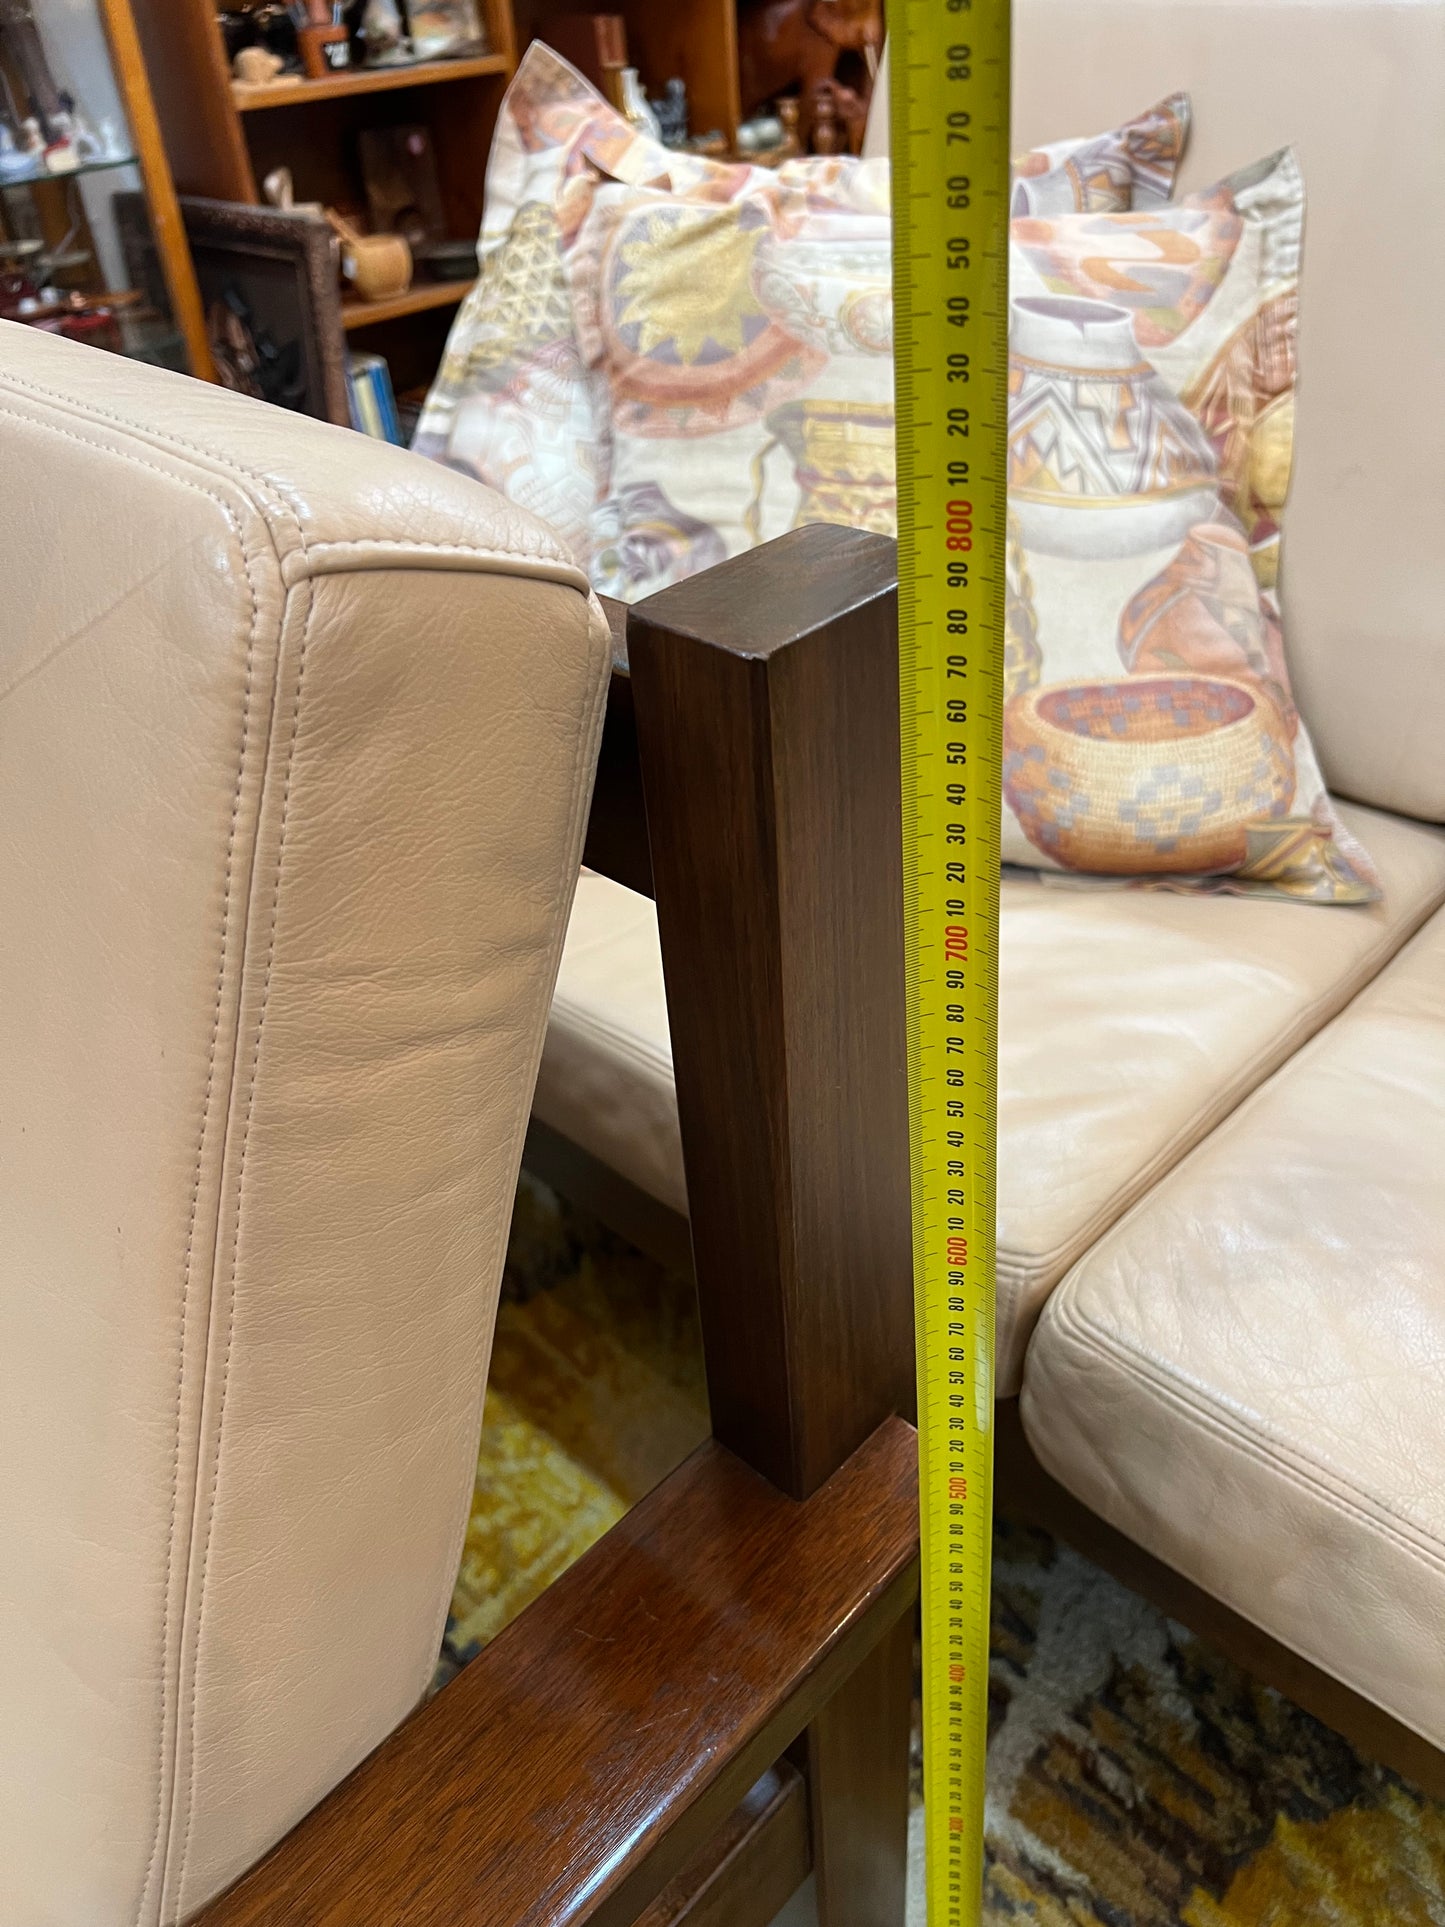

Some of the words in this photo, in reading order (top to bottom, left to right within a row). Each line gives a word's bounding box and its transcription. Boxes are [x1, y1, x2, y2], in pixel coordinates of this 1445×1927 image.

[946, 44, 972, 81] 80
[946, 111, 972, 147] 70
[946, 176, 971, 210] 60
[946, 237, 971, 270] 50
[946, 296, 971, 328] 40
[946, 353, 970, 383] 30
[946, 407, 970, 438] 20
[946, 461, 970, 487] 10
[945, 499, 974, 553] 800
[946, 561, 969, 588] 90
[946, 609, 968, 635] 80
[946, 655, 968, 679] 70
[946, 699, 968, 724] 60
[946, 742, 967, 765] 50
[946, 783, 967, 806] 40
[946, 823, 966, 845] 30
[946, 861, 966, 884] 20
[946, 899, 966, 917] 10
[945, 925, 969, 962] 700
[946, 970, 965, 989] 90
[946, 1004, 965, 1023] 80
[946, 1037, 965, 1055] 70
[946, 1069, 965, 1087] 60
[946, 1100, 965, 1118] 50
[946, 1130, 965, 1148] 40
[946, 1160, 965, 1177] 30
[946, 1189, 965, 1206] 20
[946, 1217, 965, 1231] 10
[946, 1236, 968, 1267] 600
[948, 1271, 965, 1286] 90
[948, 1296, 965, 1312] 80
[948, 1322, 965, 1337] 70
[948, 1347, 965, 1361] 60
[948, 1371, 965, 1385] 50
[948, 1394, 965, 1408] 40
[948, 1417, 965, 1431] 30
[948, 1439, 965, 1454] 20
[948, 1461, 965, 1474] 10
[948, 1477, 968, 1500] 500
[949, 1503, 964, 1516] 90
[949, 1523, 964, 1536] 80
[949, 1543, 964, 1556] 70
[949, 1562, 964, 1575] 60
[949, 1581, 964, 1593] 50
[949, 1600, 964, 1612] 40
[949, 1617, 964, 1630] 30
[949, 1635, 964, 1647] 20
[949, 1652, 964, 1662] 10
